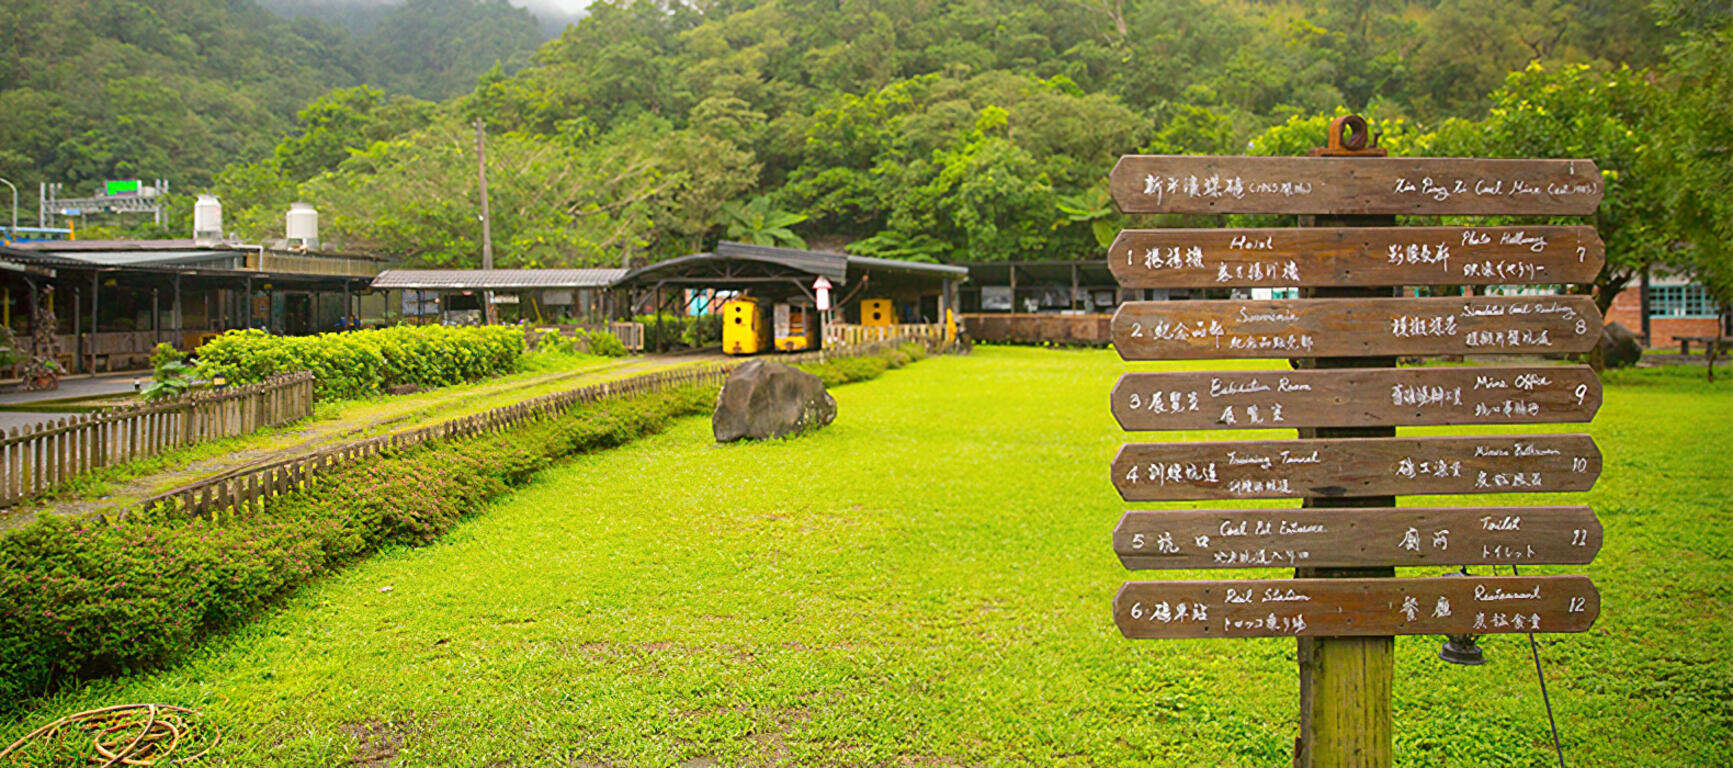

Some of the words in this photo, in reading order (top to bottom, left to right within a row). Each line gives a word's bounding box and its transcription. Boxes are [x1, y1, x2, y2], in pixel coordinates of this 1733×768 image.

[1144, 245, 1205, 270] 捲揚機
[1576, 246, 1586, 263] 7
[1130, 319, 1145, 338] 2
[1575, 319, 1587, 335] 8
[1277, 377, 1312, 392] Room
[1129, 393, 1142, 410] 3
[1574, 383, 1588, 406] 9
[1227, 450, 1272, 470] Training
[1280, 450, 1321, 464] Tunnel
[1572, 457, 1587, 473] 10
[1125, 465, 1140, 484] 4
[1219, 520, 1248, 537] Coal
[1480, 516, 1521, 531] Toilet
[1132, 533, 1145, 549] 5
[1571, 529, 1587, 546] 11
[1482, 544, 1535, 559] トイレット
[1569, 597, 1586, 613] 12
